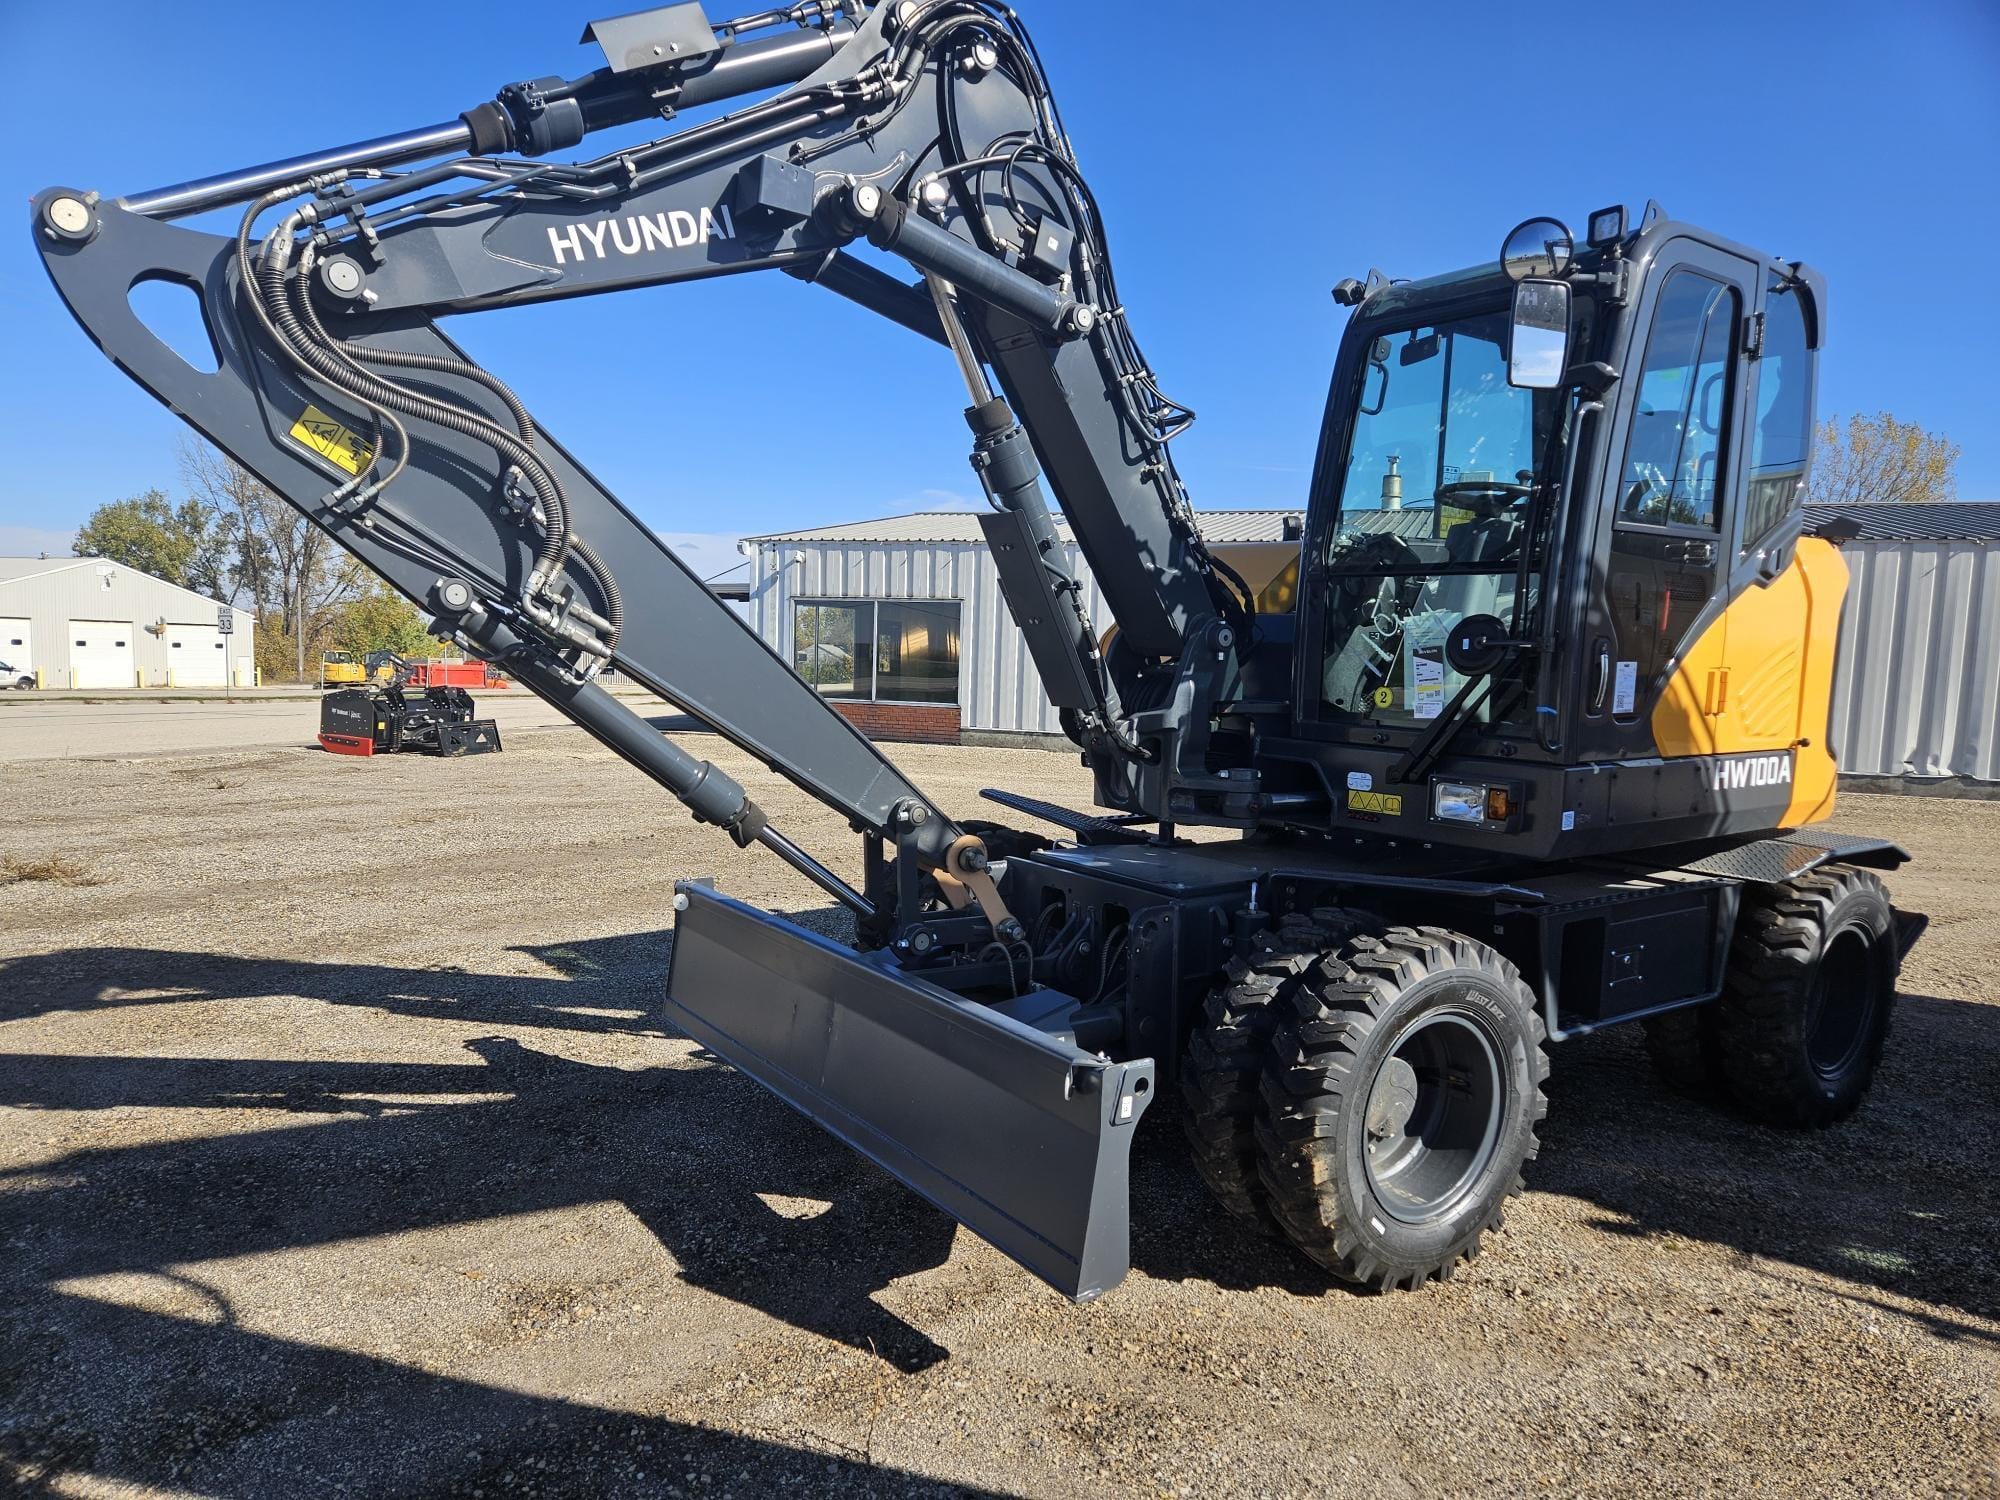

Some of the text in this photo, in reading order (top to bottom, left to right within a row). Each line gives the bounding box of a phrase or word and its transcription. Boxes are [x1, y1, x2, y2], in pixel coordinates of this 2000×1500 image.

[547, 205, 736, 263] HYUNDAI
[219, 607, 231, 615] EAST
[219, 619, 232, 630] 33
[1380, 691, 1388, 704] 2
[1713, 755, 1791, 791] HW100A
